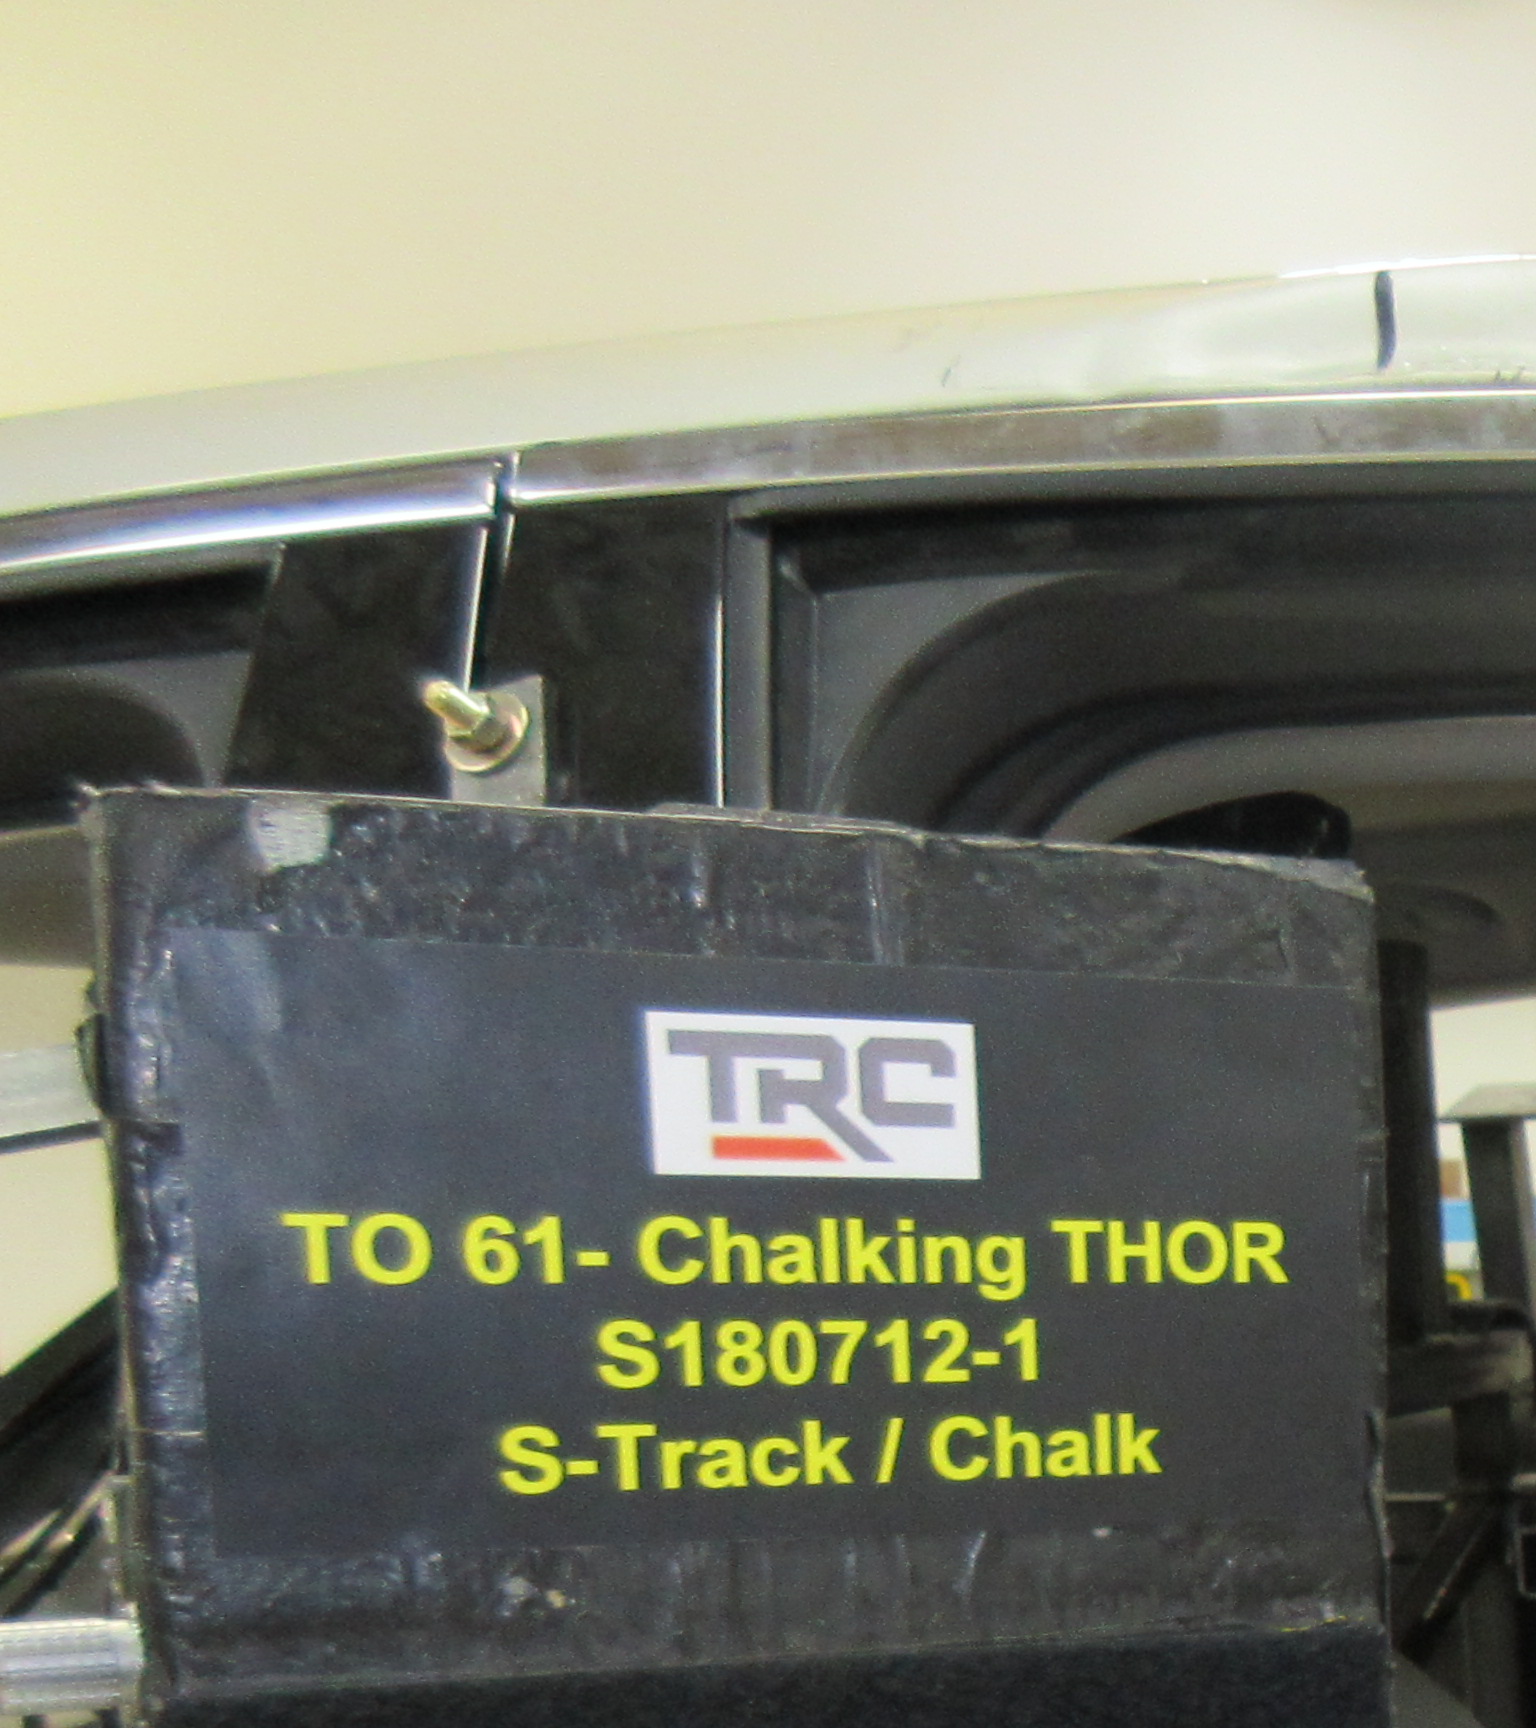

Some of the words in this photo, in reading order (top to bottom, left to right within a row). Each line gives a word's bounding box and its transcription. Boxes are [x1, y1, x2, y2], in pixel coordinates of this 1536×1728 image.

[666, 1029, 957, 1163] TRC
[283, 1212, 432, 1286] TO
[463, 1213, 611, 1286] 61-
[637, 1214, 1028, 1302] Chalking
[1049, 1217, 1290, 1286] THOR
[595, 1317, 1040, 1390] S180712-1
[498, 1418, 855, 1495] S-Track
[875, 1416, 905, 1484] /
[928, 1412, 1163, 1482] Chalk
